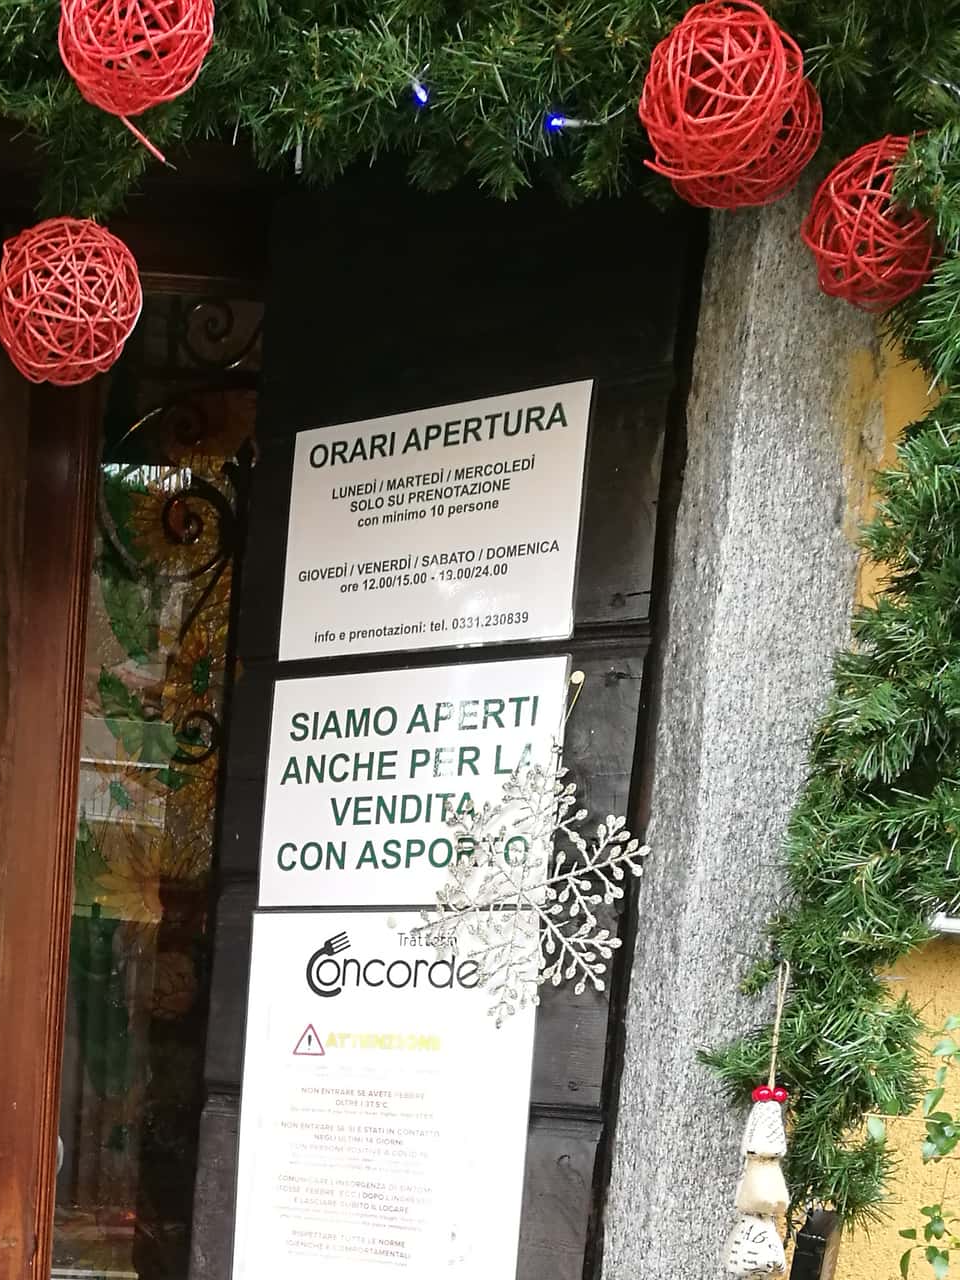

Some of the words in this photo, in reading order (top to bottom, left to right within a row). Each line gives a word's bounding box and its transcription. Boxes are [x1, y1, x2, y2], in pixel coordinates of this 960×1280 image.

[309, 430, 396, 469] ORARI
[402, 401, 569, 455] APERTURA
[331, 477, 378, 500] LUNEDÌ
[386, 468, 445, 492] MARTEDÌ
[454, 454, 536, 481] MERCOLEDÌ
[349, 497, 385, 513] SOLO
[387, 493, 405, 508] SU
[408, 478, 511, 505] PRENOTAZIONE
[357, 515, 379, 528] con
[382, 507, 427, 525] minimo
[430, 503, 445, 519] 10
[447, 498, 500, 522] persone
[298, 562, 347, 583] GIOVEDÌ
[357, 553, 411, 576] VENERDÌ
[422, 549, 476, 569] SABATO
[486, 539, 560, 561] DOMENICA
[340, 580, 359, 594] ore
[362, 571, 427, 592] 12.00/15.00
[313, 628, 336, 644] info
[339, 630, 346, 641] e
[349, 620, 427, 643] prenotazioni:
[429, 617, 449, 633] tel.
[451, 611, 529, 631] 0331.230839
[289, 704, 398, 743] SIAMO
[406, 695, 540, 734] APERTI
[280, 748, 398, 786] ANCHE
[409, 745, 481, 780] PER
[494, 743, 533, 776] LA
[330, 791, 477, 827] VENDITA
[276, 841, 346, 872] CON
[306, 937, 482, 998] Concorde
